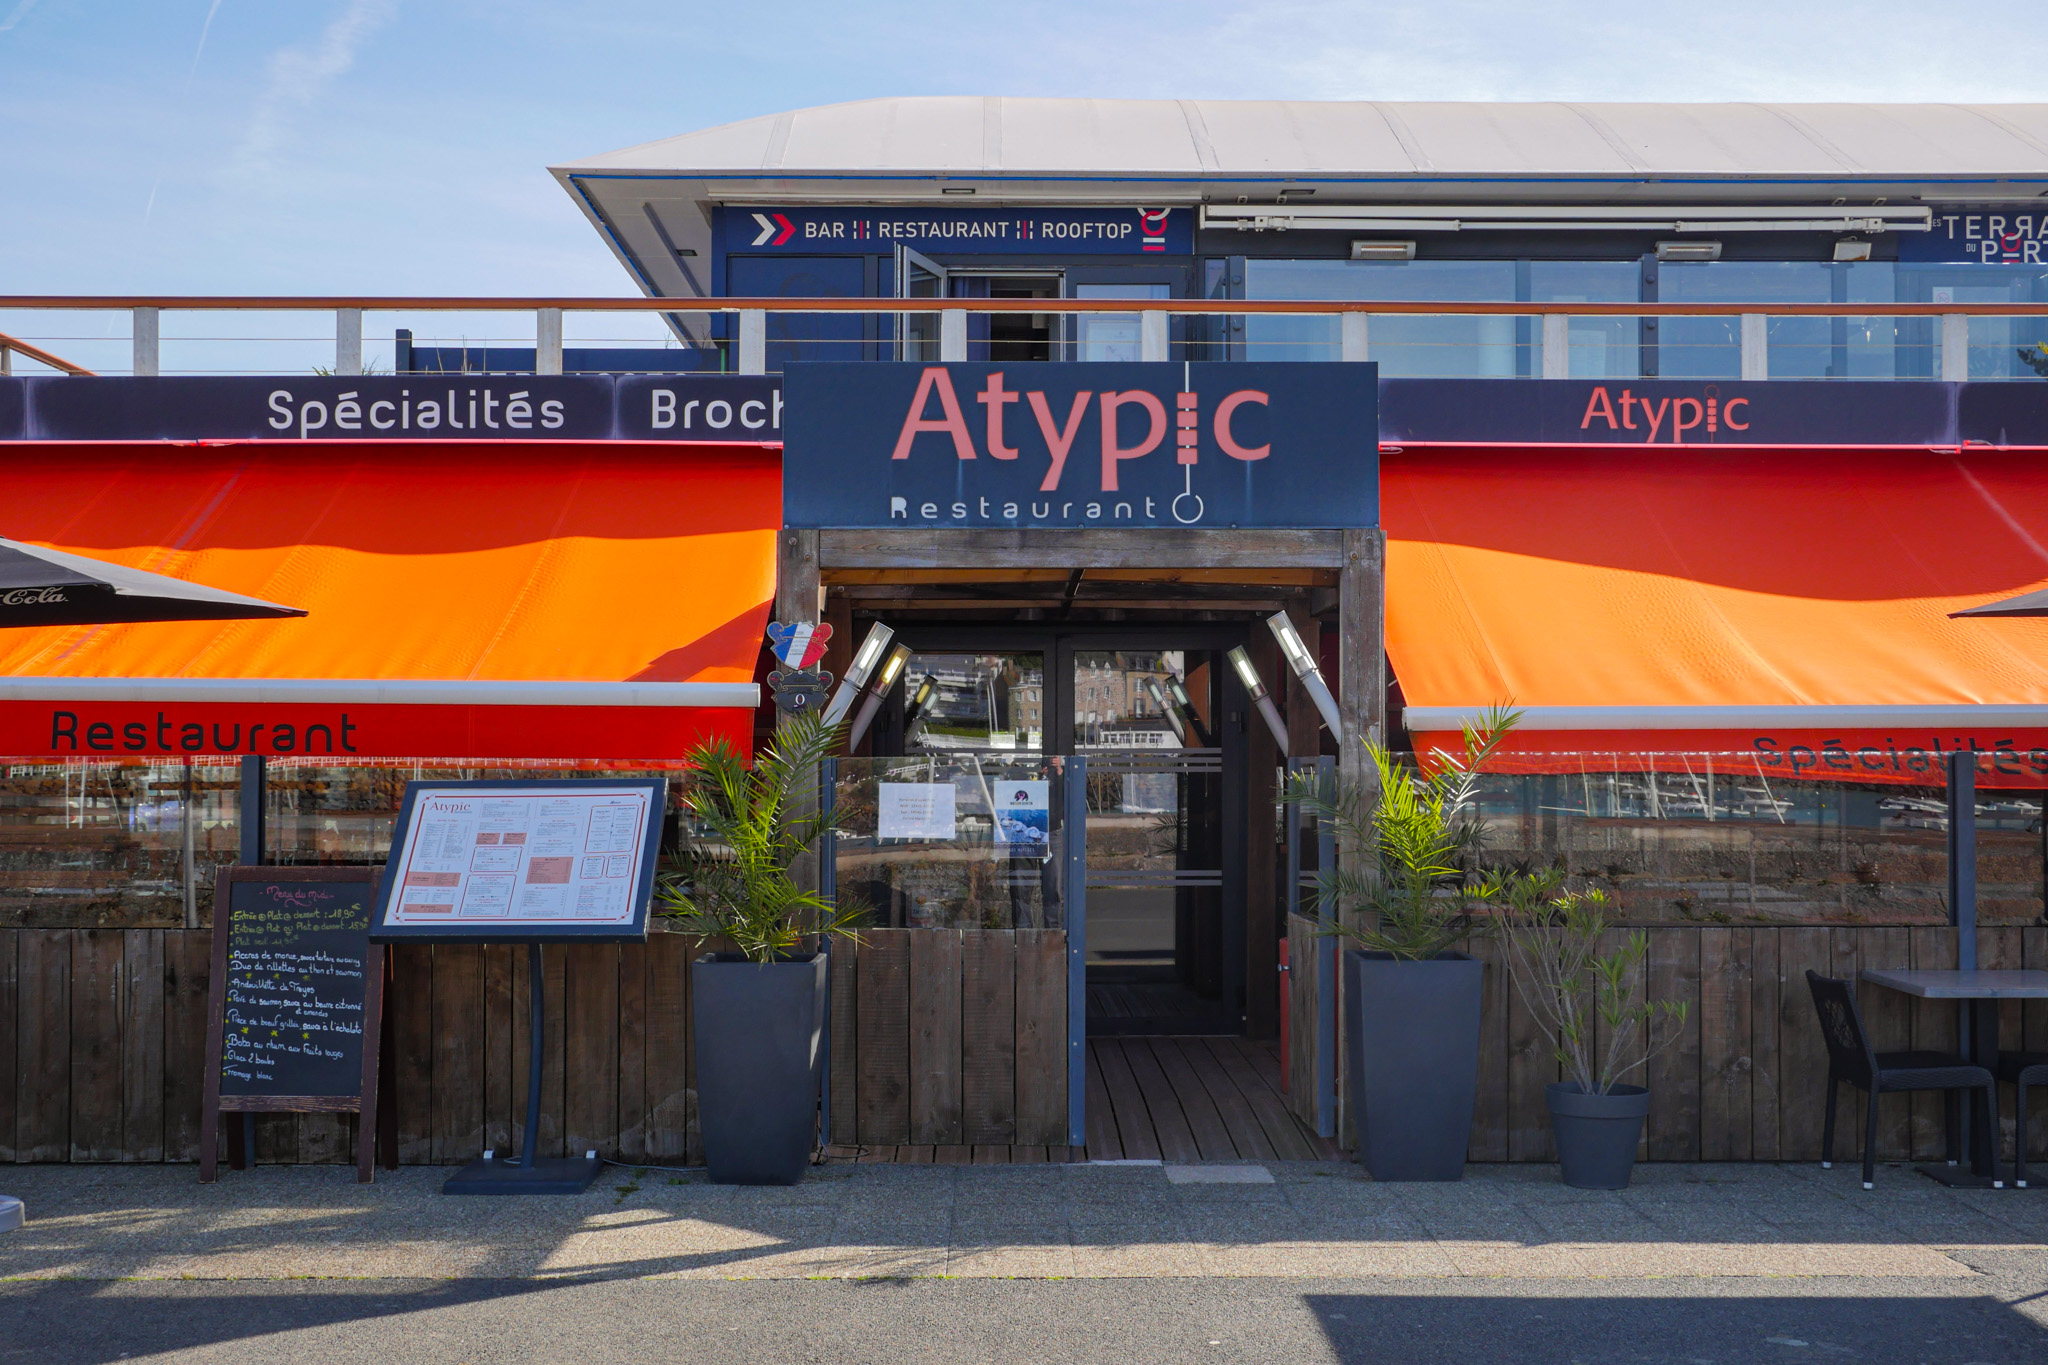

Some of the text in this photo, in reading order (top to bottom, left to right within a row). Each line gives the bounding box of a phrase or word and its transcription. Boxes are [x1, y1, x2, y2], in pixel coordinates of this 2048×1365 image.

[805, 222, 1132, 240] BAR RESTAURANT ROOFTOP
[1930, 219, 1942, 227] ES
[267, 389, 566, 439] Spécialités
[1581, 386, 1750, 443] Atypic
[891, 366, 1271, 492] Atypic
[890, 496, 1156, 520] Restaurant
[51, 710, 358, 753] Restaurant
[430, 801, 471, 814] Atypic
[295, 888, 306, 899] du
[233, 949, 260, 960] Accras
[261, 949, 272, 960] de
[230, 960, 253, 971] Duo
[254, 961, 265, 971] de
[326, 963, 335, 975] et
[279, 982, 291, 992] de
